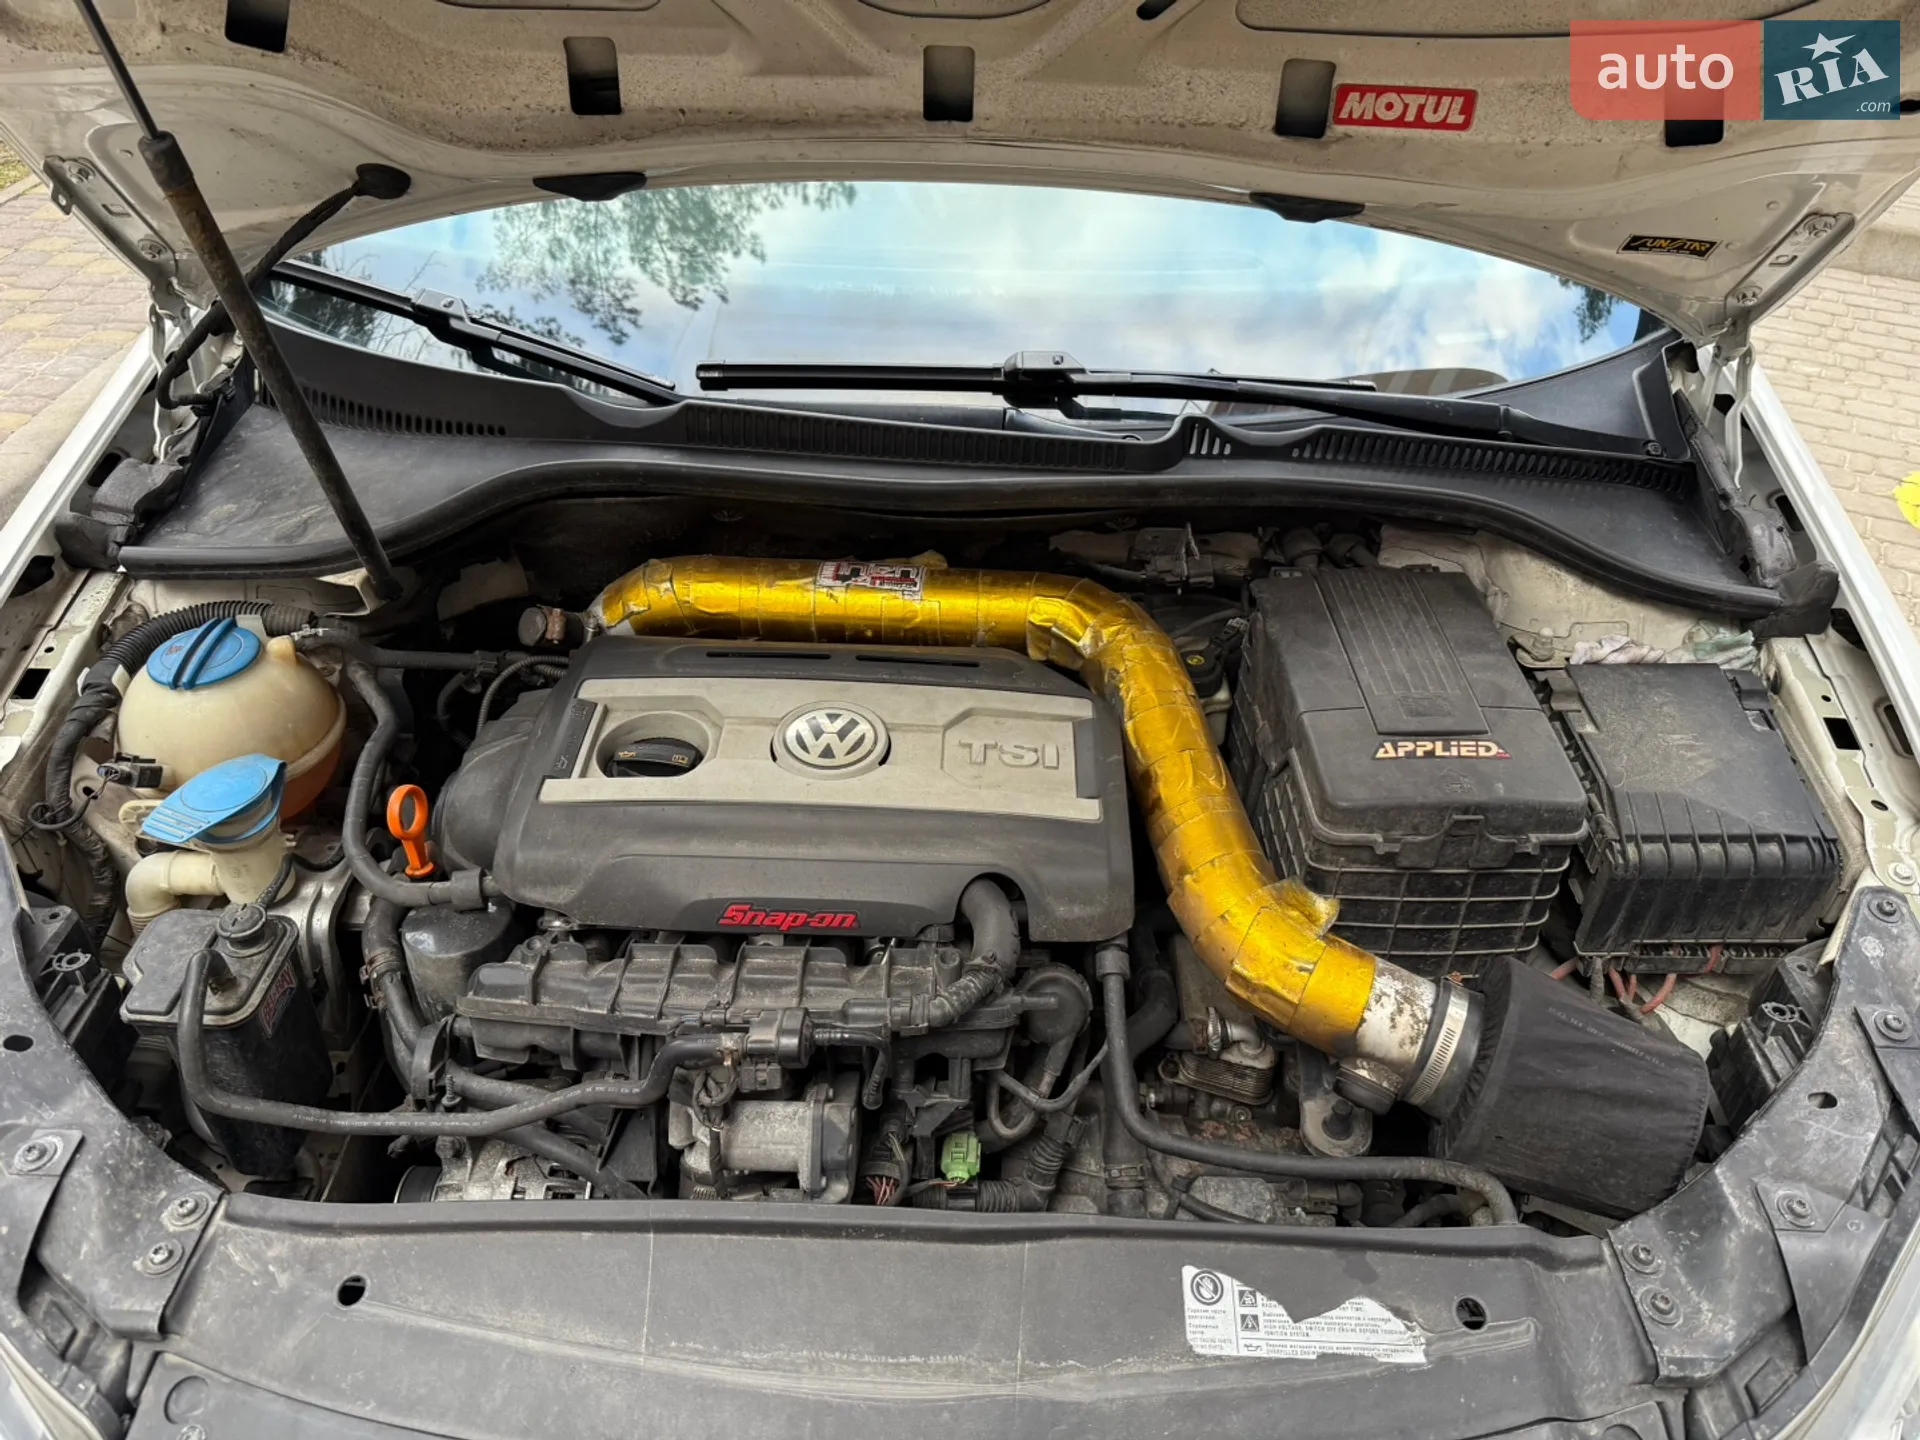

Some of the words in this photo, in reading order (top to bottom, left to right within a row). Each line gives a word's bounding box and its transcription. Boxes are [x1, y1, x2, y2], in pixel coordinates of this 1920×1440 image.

[1338, 92, 1466, 124] MOTUL
[958, 735, 1060, 770] TSI
[718, 904, 857, 931] Snap-on
